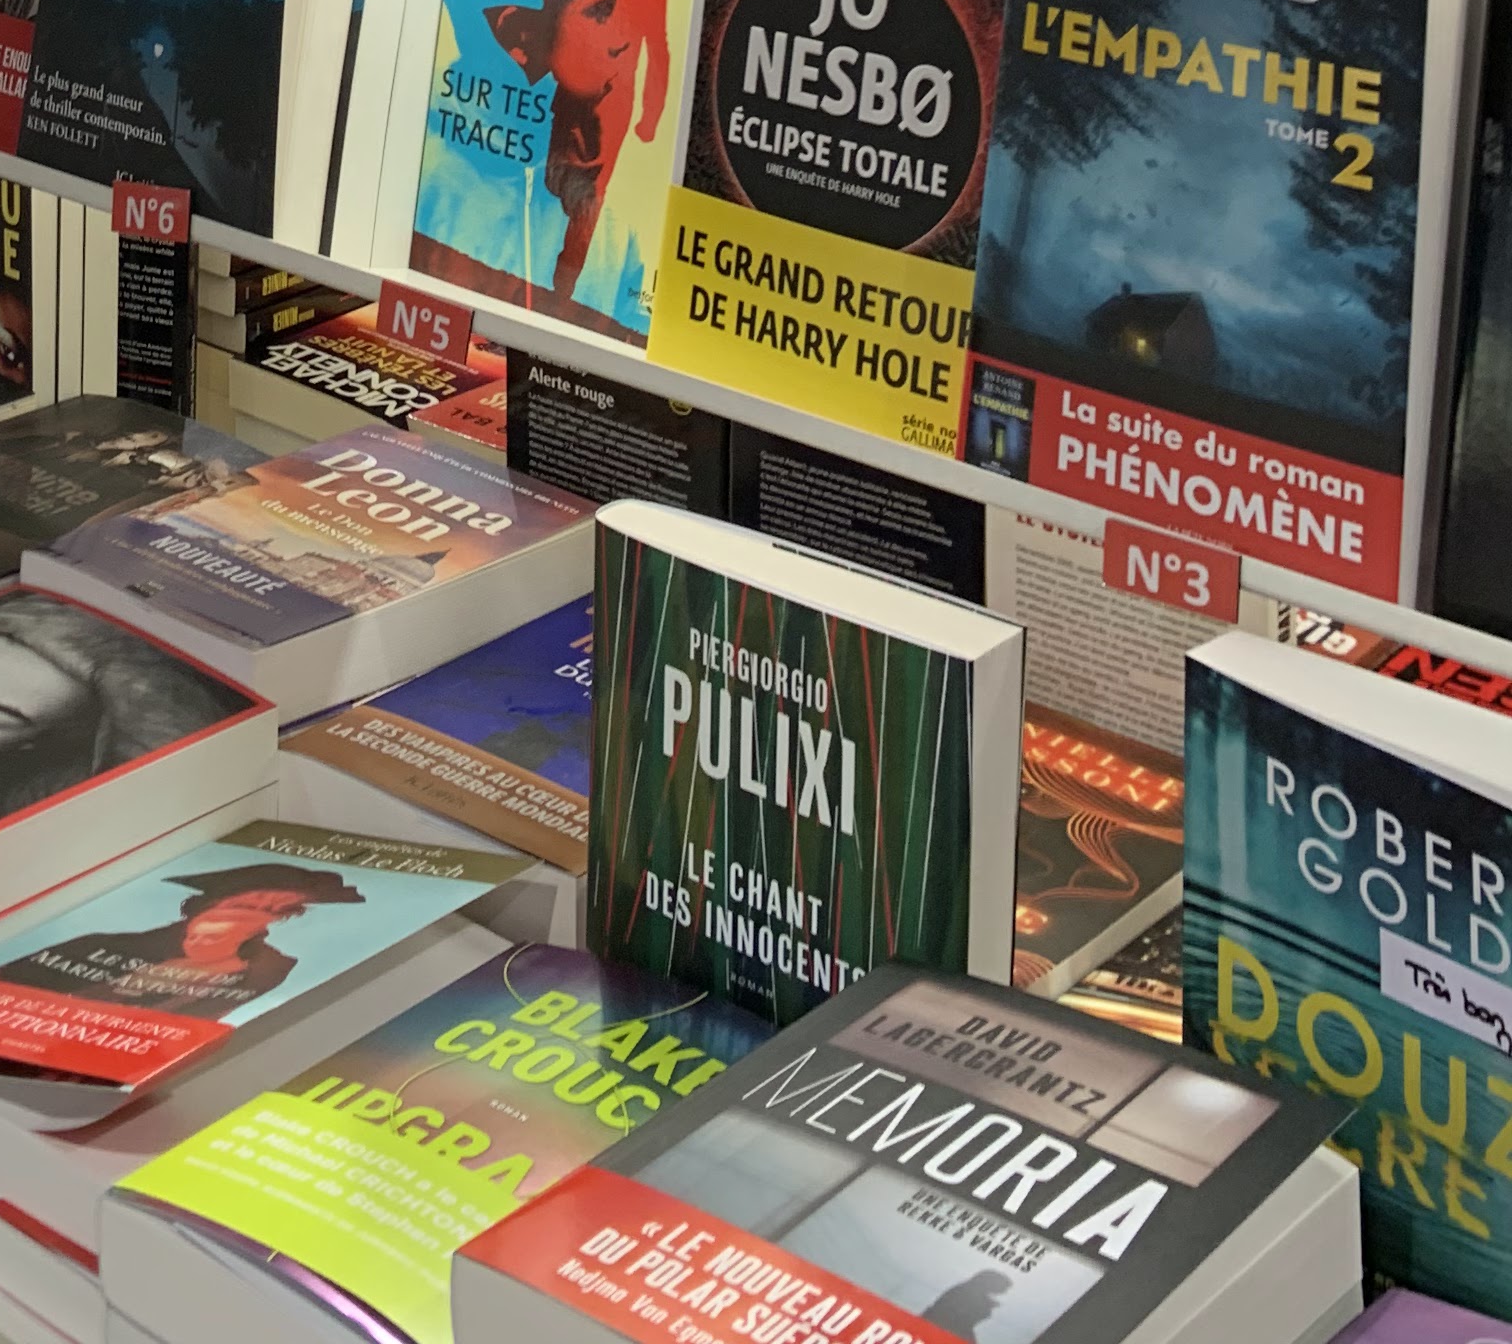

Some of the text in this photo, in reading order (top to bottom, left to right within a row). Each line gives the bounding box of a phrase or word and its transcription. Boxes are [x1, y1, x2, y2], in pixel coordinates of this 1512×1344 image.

[33, 64, 144, 113] Le plus grand auteur
[441, 67, 548, 124] SUR TES
[742, 25, 956, 139] NESBØ
[1022, 0, 1383, 127] L'EMPATHIE
[26, 114, 99, 150] KEN FOLLETT
[29, 92, 167, 146] de thriller contemporain.
[437, 108, 536, 165] TRACES
[727, 105, 950, 200] ÉCLIPSE TOTALE
[1264, 116, 1375, 193] TOME 2
[125, 195, 176, 235] N°6
[764, 160, 902, 210] UNE ENQUÊTE DE HARRY HOLE
[676, 224, 709, 270] LE
[714, 239, 825, 306] GRAND
[392, 299, 451, 351] N°5
[688, 284, 952, 404] DE HARRY HOLE
[261, 351, 413, 419] MICHAEL
[267, 342, 441, 410] CONNELLY
[528, 365, 616, 410] Alerte rouge
[901, 412, 935, 433] série
[1059, 389, 1366, 507] La suite du roman
[299, 469, 452, 543] Leon
[318, 448, 513, 536] Donna
[1056, 428, 1365, 565] PHÉNOMÈNE
[149, 534, 288, 596] NOUVEAUTÉ
[1125, 544, 1213, 608] N°3
[689, 626, 830, 714] PIERGIORGIO
[326, 723, 508, 803] LA SECONDE GUERRE
[363, 719, 577, 817] DES VAMPIRES AU CŒUR
[662, 664, 857, 837] PULIXI
[256, 835, 466, 879] Nicolas Le Floch
[1264, 755, 1506, 917] ROBER
[644, 870, 692, 928] DES
[687, 841, 823, 938] LE CHANT
[1297, 837, 1511, 976] GOLD
[862, 1014, 1110, 1116] LAGERCRANTZ
[955, 1014, 1064, 1064] DAVID
[433, 1019, 666, 1137] CROUC
[314, 1129, 418, 1183] CROUCH
[742, 1046, 1170, 1262] MEMORIA
[896, 1200, 1039, 1275] REKKE VARGAS
[911, 1187, 1048, 1259] UNE DE
[556, 1257, 629, 1305] Nedjma
[578, 1226, 741, 1320] DU POLAR
[663, 1221, 864, 1337] LE NOUVEAU
